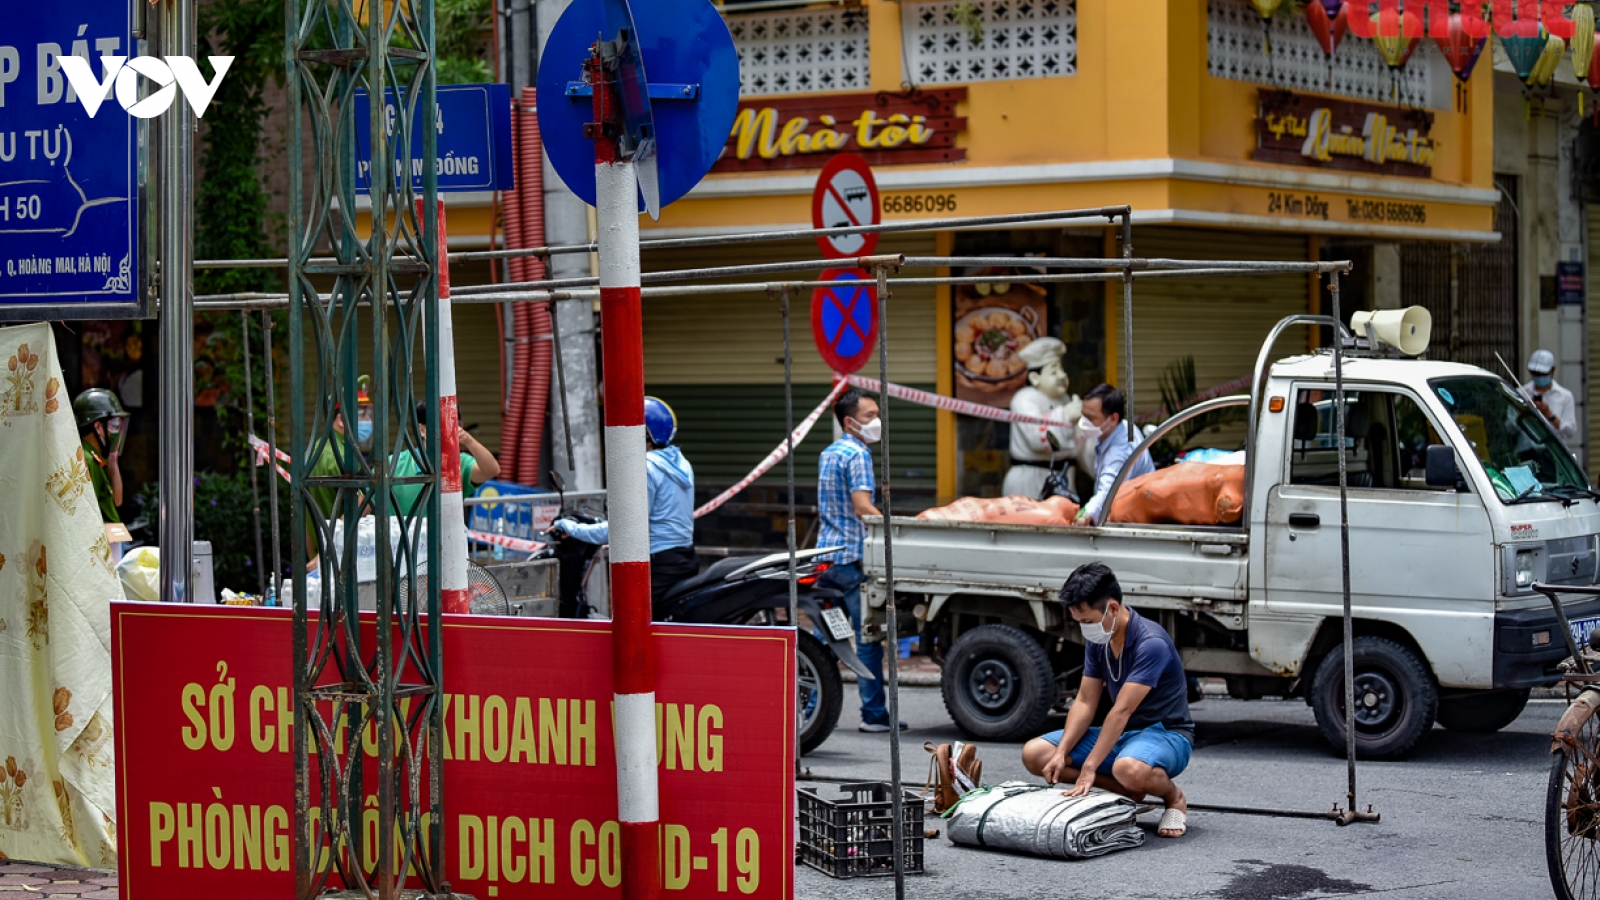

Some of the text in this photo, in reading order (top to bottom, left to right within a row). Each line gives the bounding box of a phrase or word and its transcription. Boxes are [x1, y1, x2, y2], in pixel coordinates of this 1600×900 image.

[731, 108, 936, 159] Nhà tôi
[16, 194, 41, 220] 50
[882, 194, 957, 213] 6686096
[1268, 192, 1282, 213] 24
[1284, 194, 1303, 215] Kim
[1386, 203, 1426, 223] 6686096
[7, 252, 111, 277] Q. HOÀNG MAI, HÀ NỘI
[181, 660, 236, 751] SỞ
[149, 786, 290, 872] PHÒNG
[458, 814, 555, 897] DỊCH
[569, 818, 760, 895] COD-19
